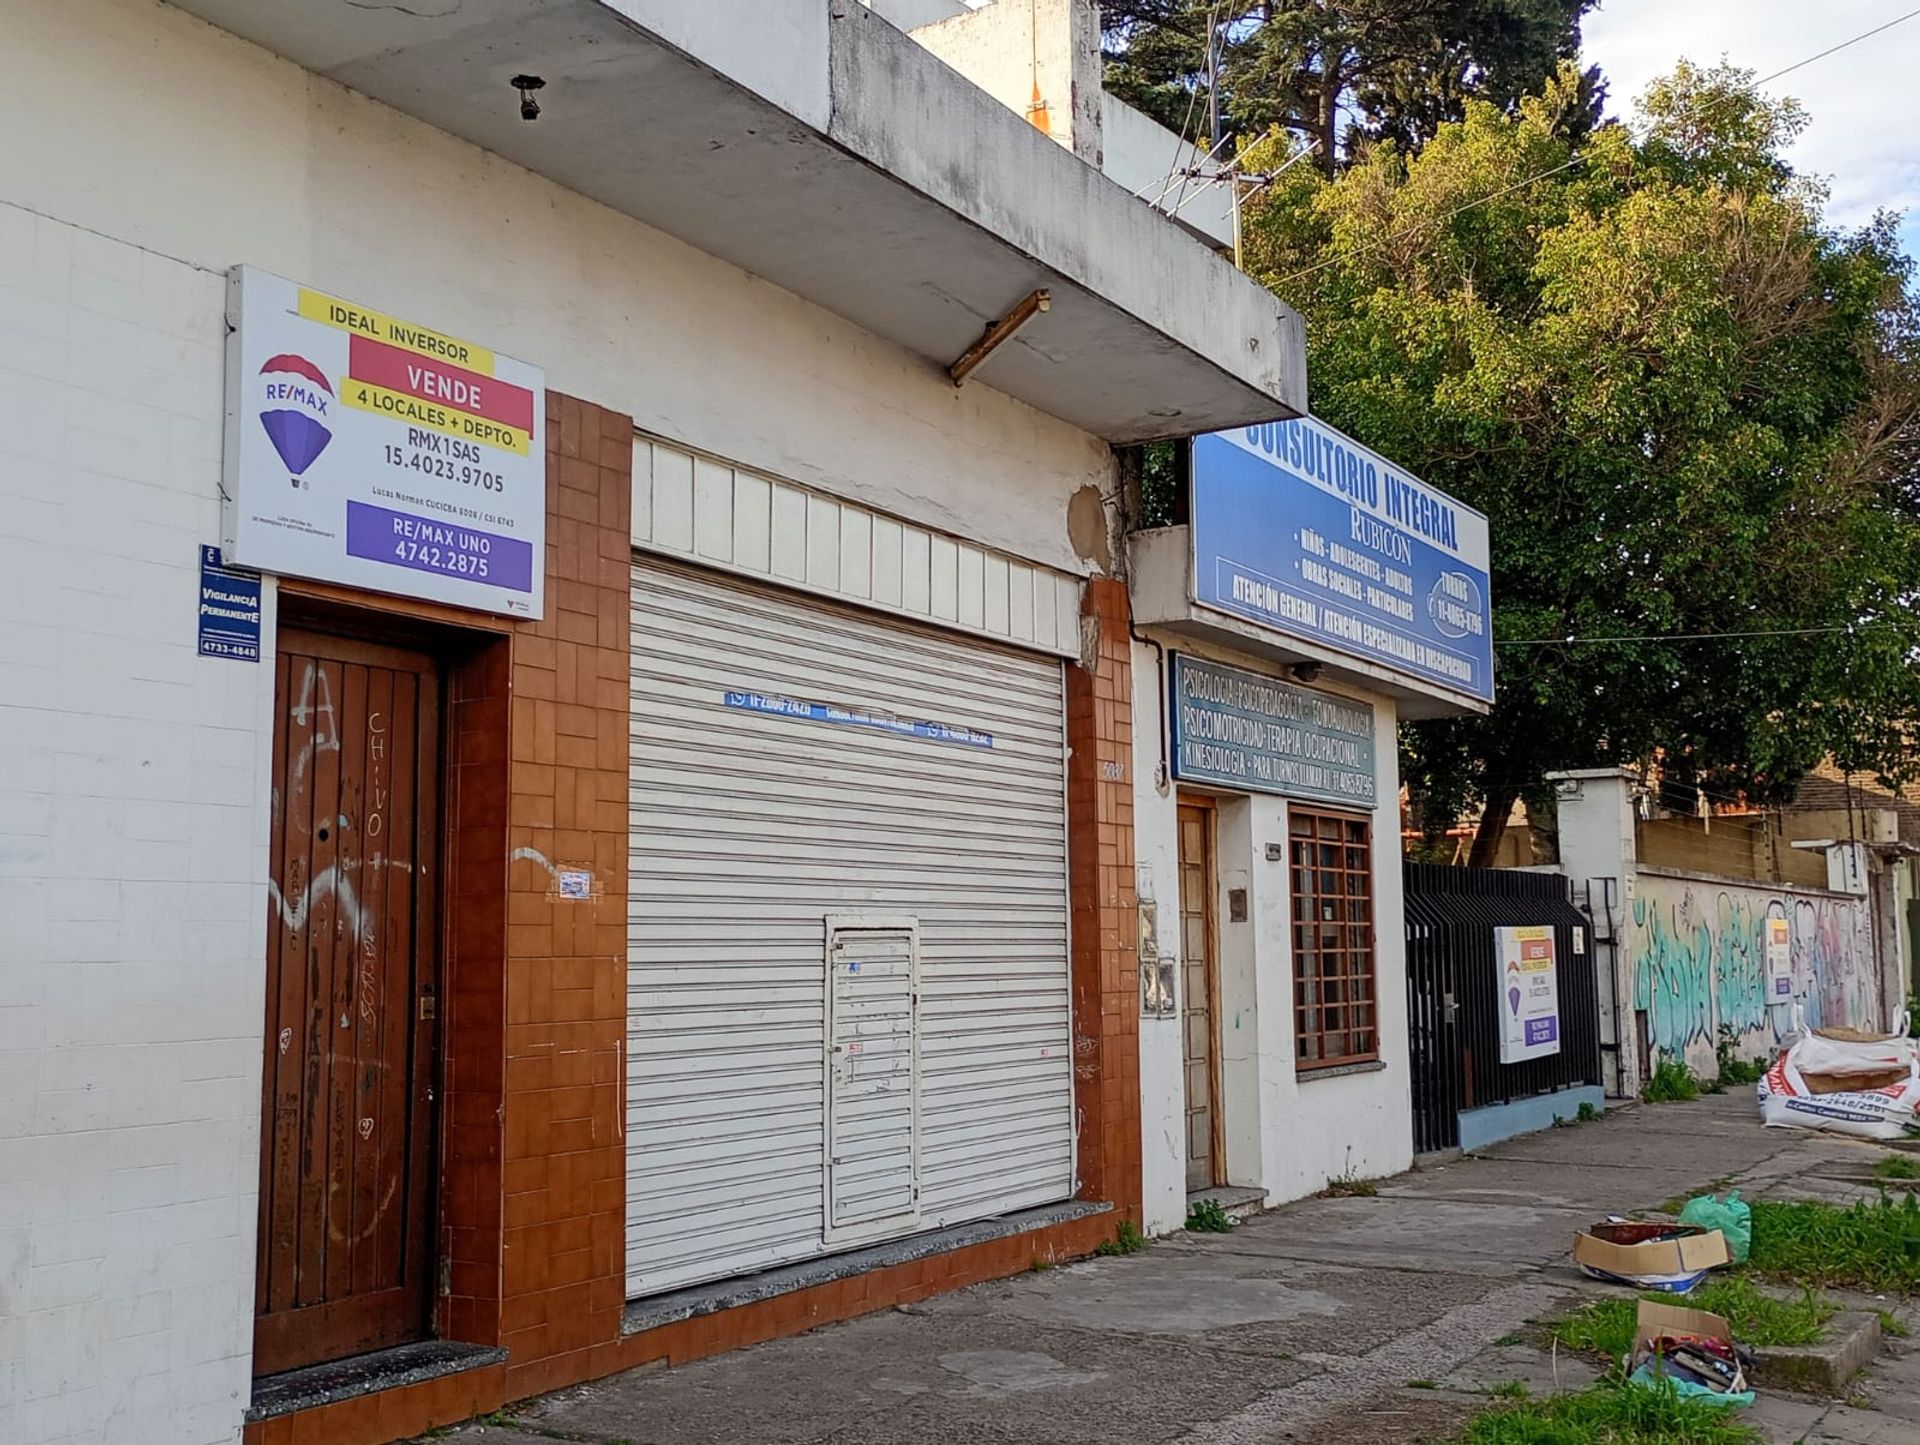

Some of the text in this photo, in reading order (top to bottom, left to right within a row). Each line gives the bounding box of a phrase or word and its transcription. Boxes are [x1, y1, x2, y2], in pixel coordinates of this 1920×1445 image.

[330, 305, 469, 363] IDEAL INVERSOR
[266, 383, 328, 417] RE/MAX
[407, 364, 482, 409] VENDE
[357, 389, 368, 404] 4
[373, 392, 446, 426] LOCALES
[463, 419, 517, 448] DEPTO.
[384, 445, 505, 493] 15.4023.9705
[1384, 472, 1458, 551] INTEGRAL
[393, 517, 491, 554] RE/MAX UNO
[395, 540, 488, 576] 4742.2875
[1302, 557, 1328, 588] OBRAS
[200, 603, 260, 623] PERMANENTE
[1233, 573, 1279, 613] ATENCIÓN
[1280, 592, 1318, 628] GENERAL
[1324, 608, 1362, 642] ATENCIÓN
